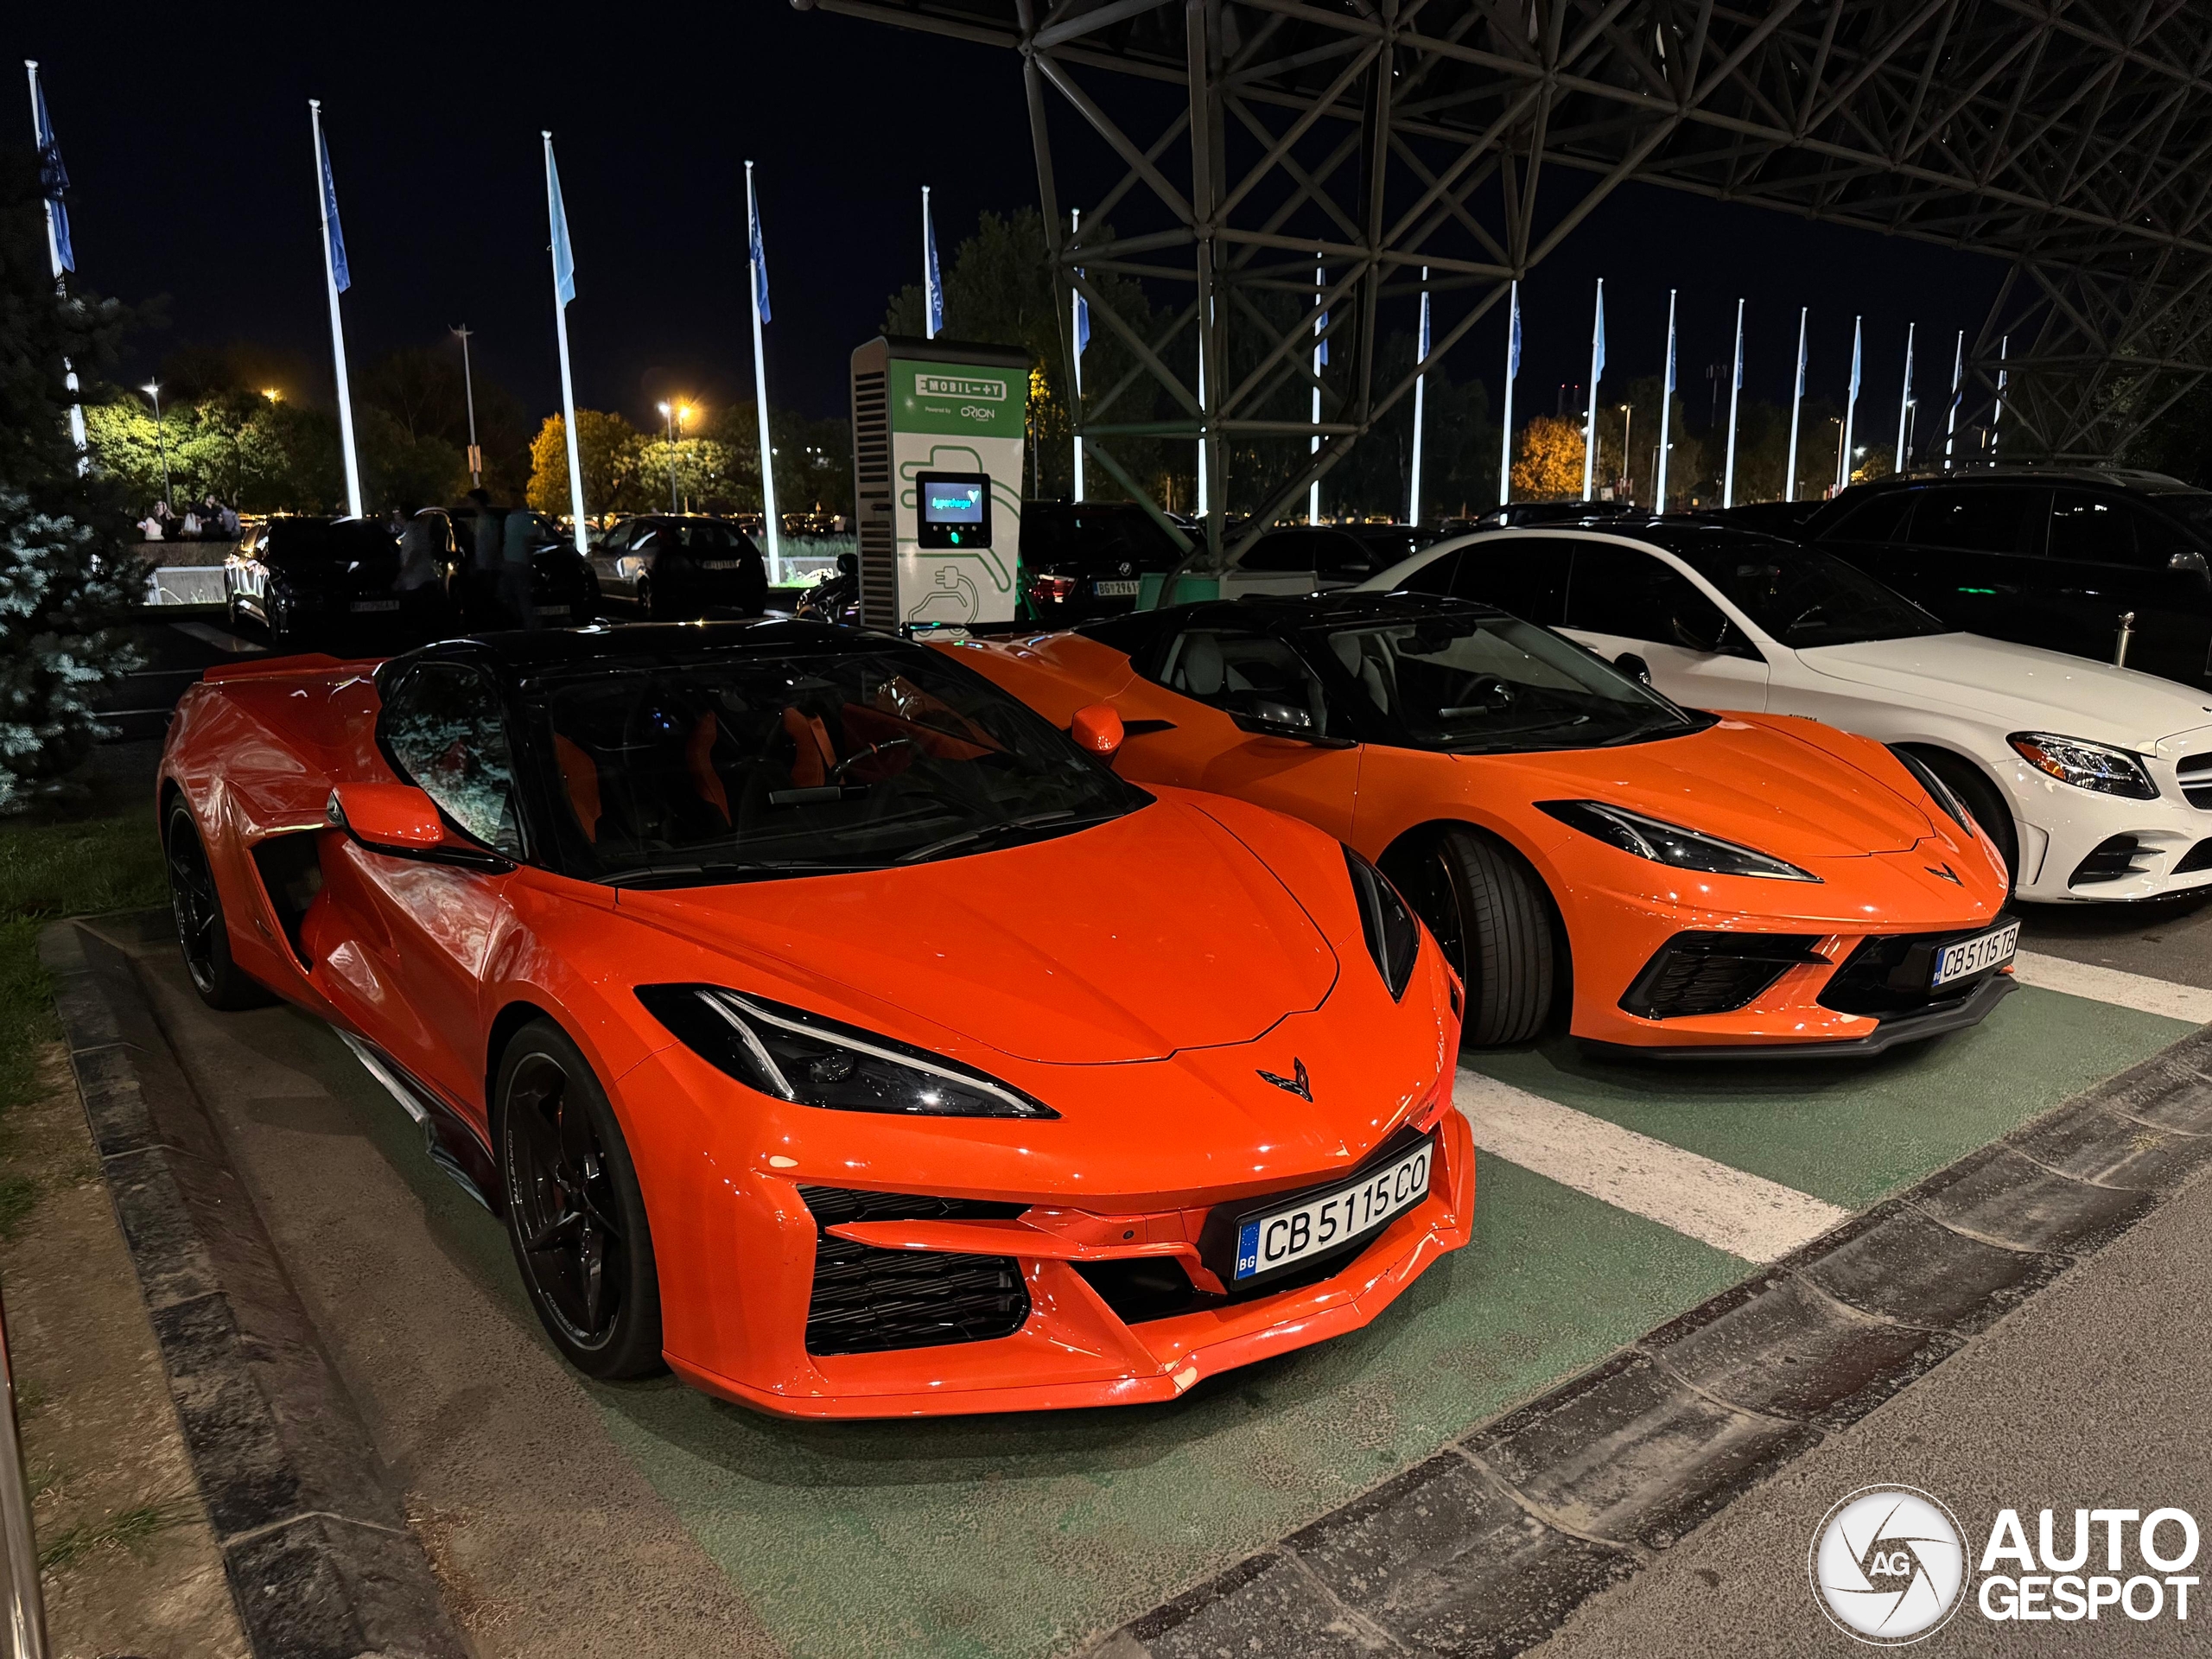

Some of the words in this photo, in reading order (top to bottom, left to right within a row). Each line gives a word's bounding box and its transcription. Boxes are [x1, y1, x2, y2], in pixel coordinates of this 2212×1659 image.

[961, 405, 995, 418] ORION
[1098, 582, 1110, 594] BG
[1943, 945, 1966, 978] CB
[1965, 933, 2000, 970] 5115
[2000, 927, 2016, 957] TB
[508, 1129, 519, 1204] CORVETTE
[1264, 1211, 1311, 1262] CB
[1318, 1173, 1391, 1243] 5115
[1394, 1154, 1426, 1204] CO
[1238, 1255, 1255, 1272] BG
[545, 1292, 574, 1331] FORGED
